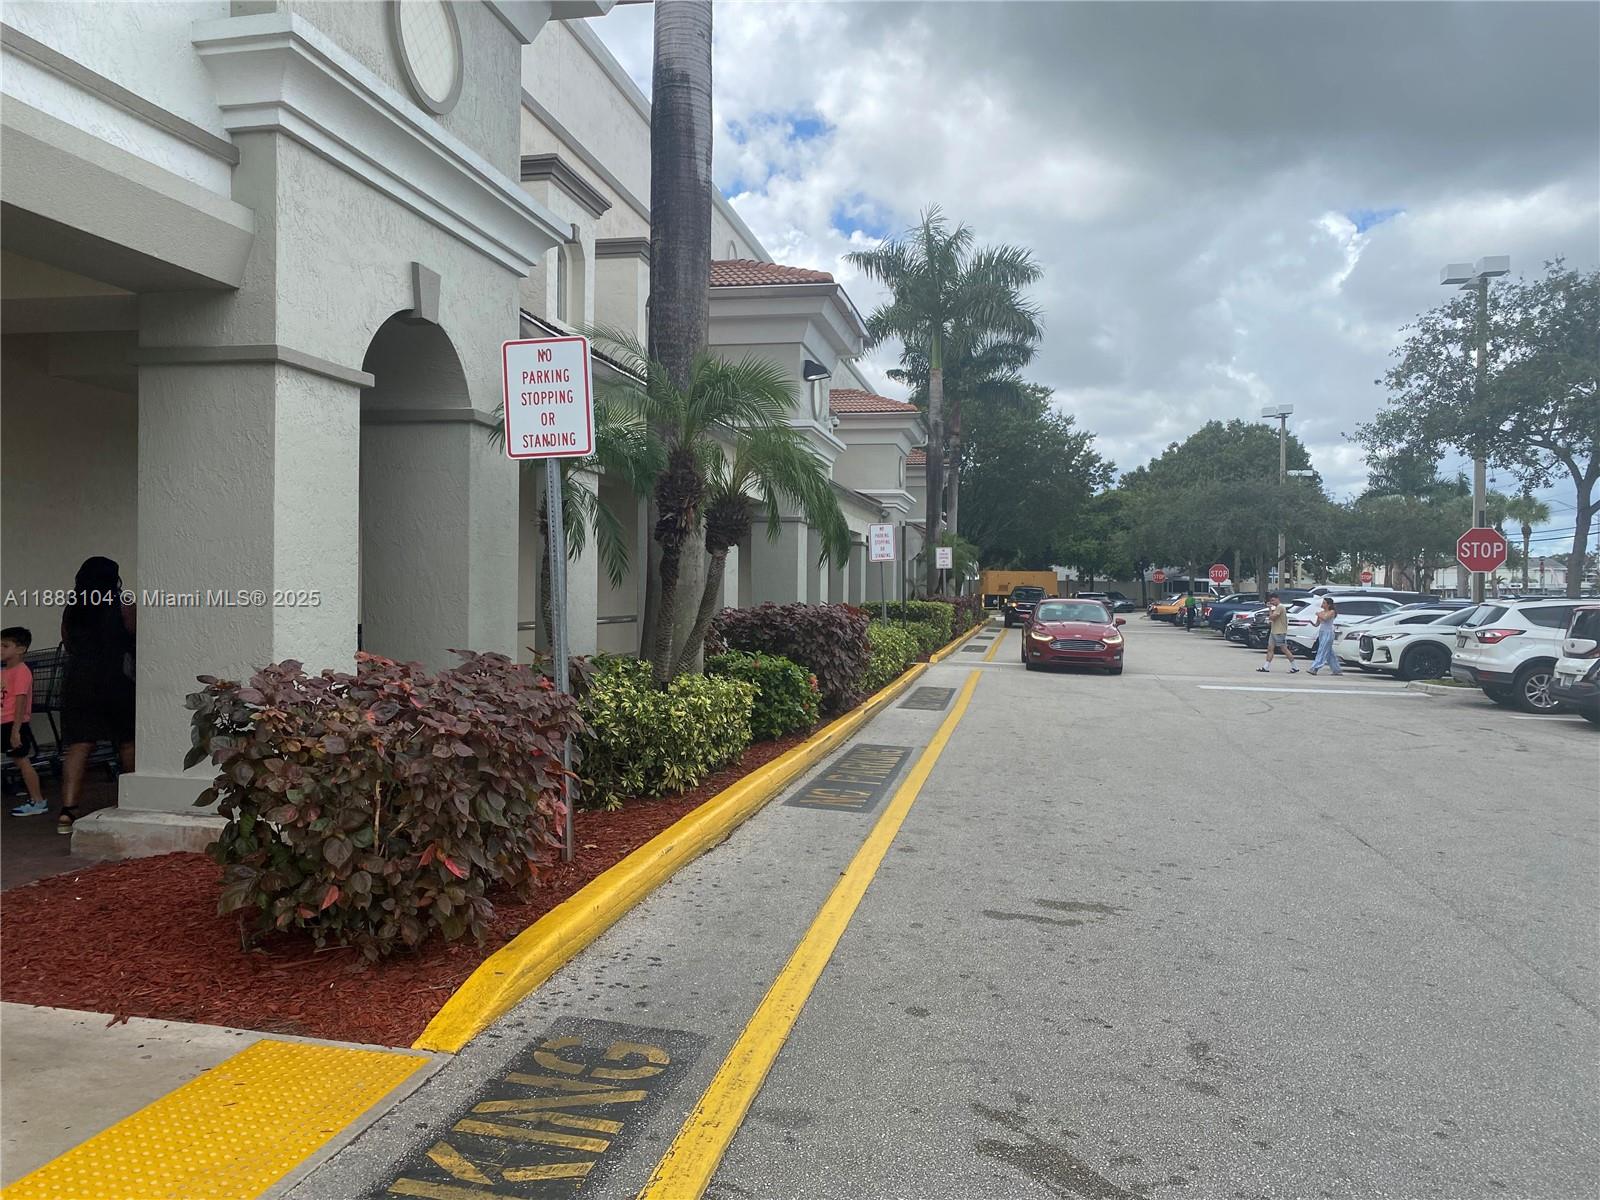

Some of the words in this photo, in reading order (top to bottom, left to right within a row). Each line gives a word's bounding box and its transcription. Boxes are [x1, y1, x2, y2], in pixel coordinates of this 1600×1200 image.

[537, 348, 552, 362] NO
[522, 369, 570, 384] PARKING
[521, 390, 573, 406] STOPPING
[541, 412, 556, 426] OR
[522, 432, 576, 448] STANDING
[1460, 542, 1504, 559] STOP
[1210, 570, 1228, 578] STOP
